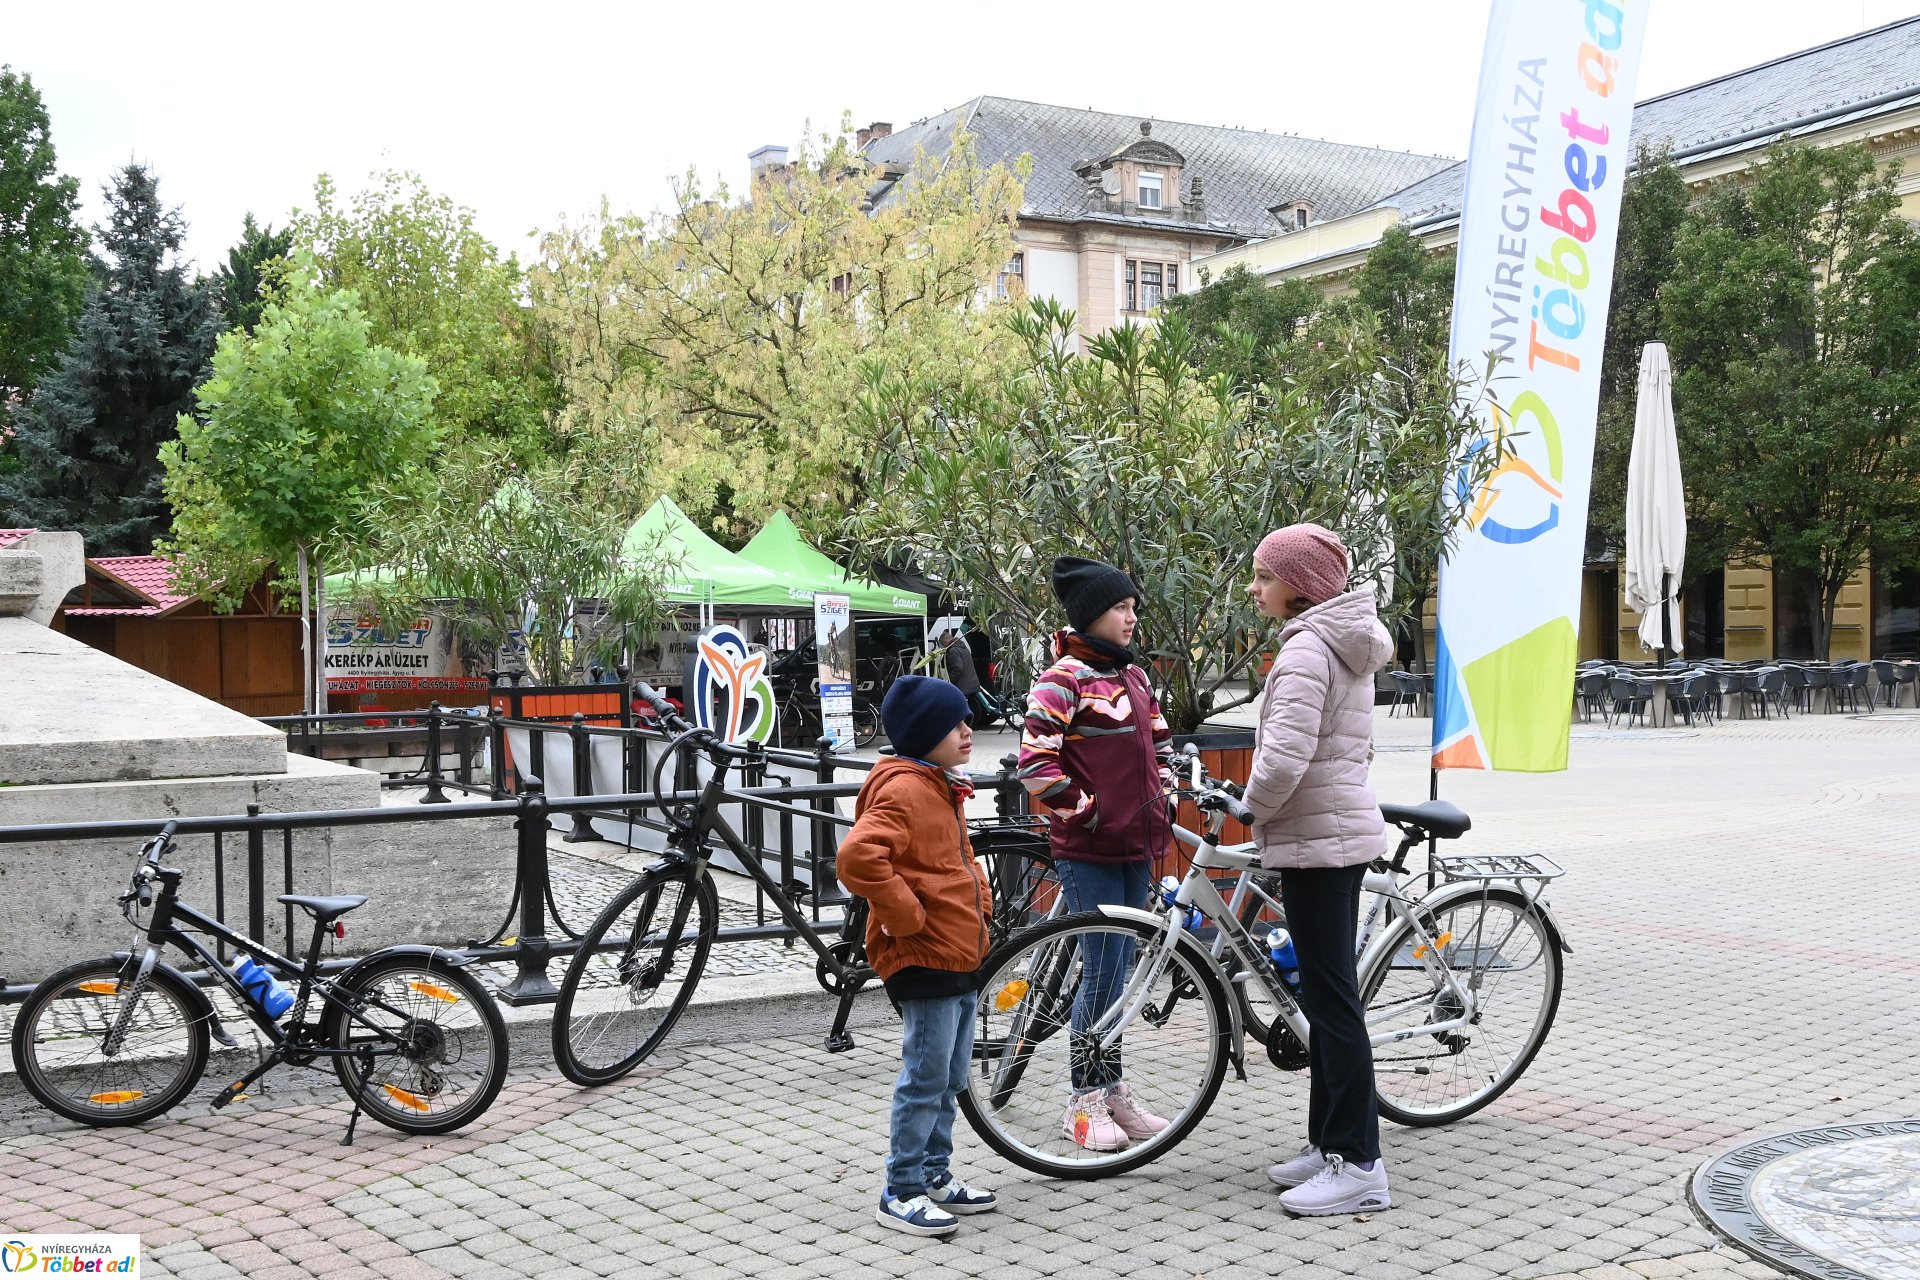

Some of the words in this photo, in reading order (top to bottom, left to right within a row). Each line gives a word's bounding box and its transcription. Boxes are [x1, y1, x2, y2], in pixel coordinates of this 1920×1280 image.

[1485, 57, 1548, 364] NYÍREGYHÁZA
[1528, 106, 1609, 373] Többet
[1577, 0, 1627, 98] ad
[821, 604, 848, 615] SZIGET
[898, 598, 921, 609] GIANT
[195, 948, 257, 1014] TREK
